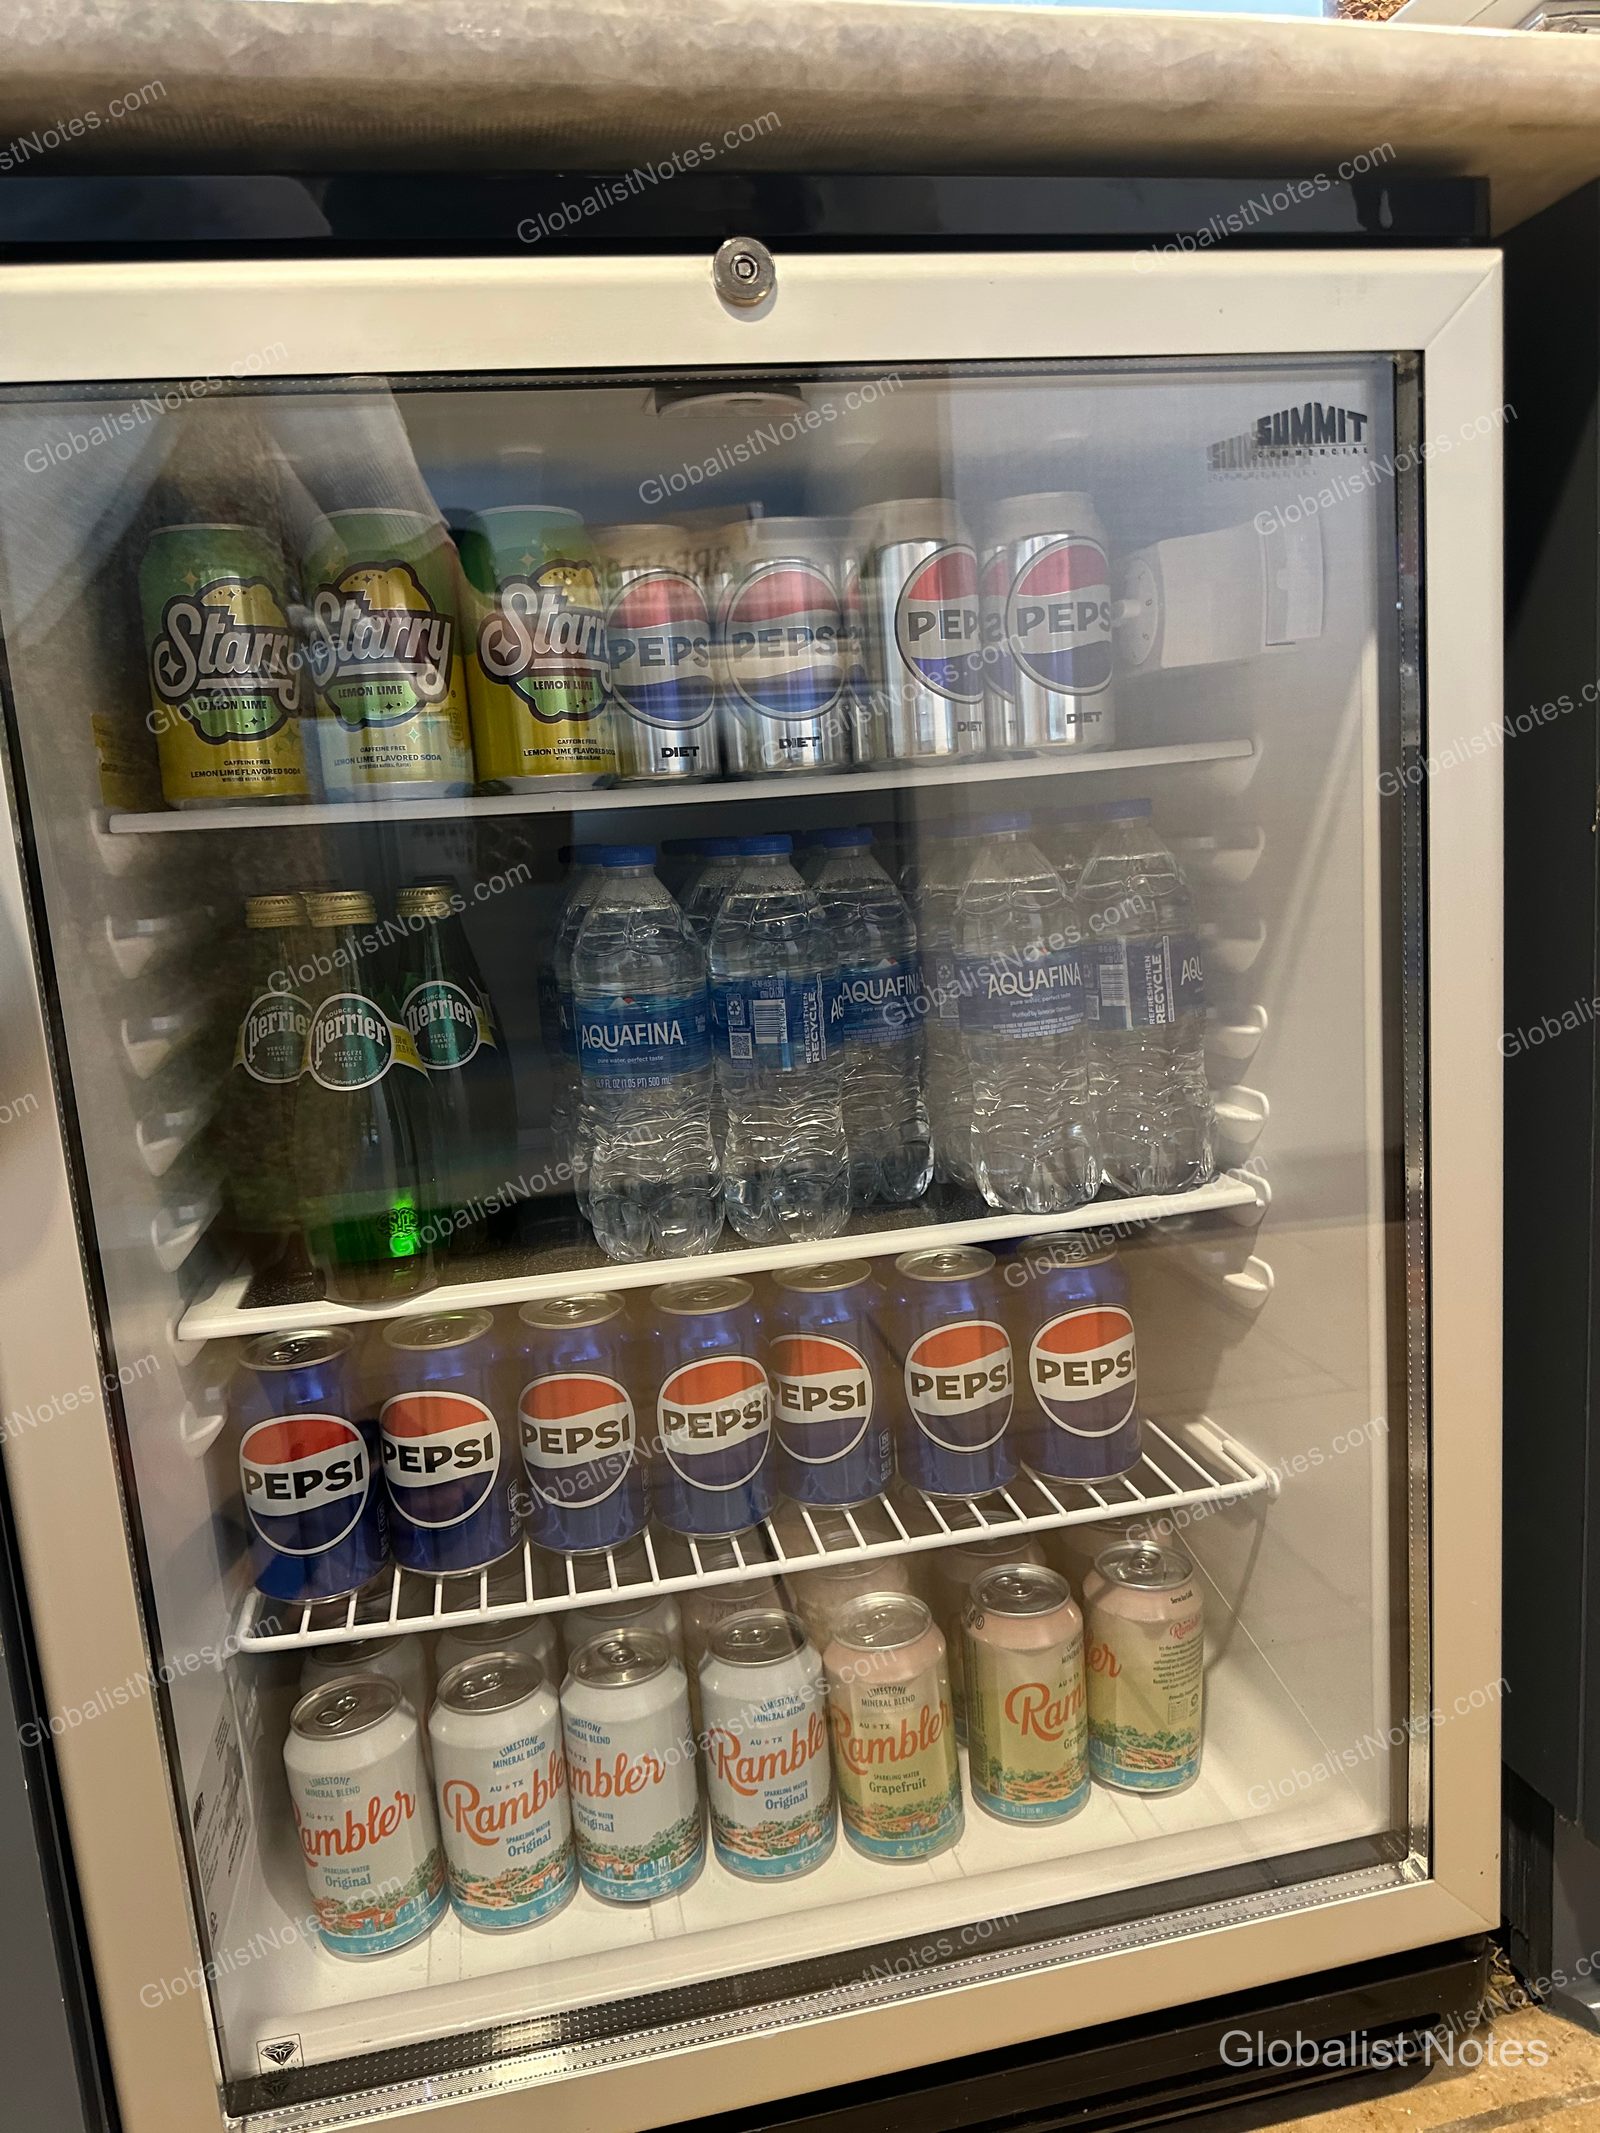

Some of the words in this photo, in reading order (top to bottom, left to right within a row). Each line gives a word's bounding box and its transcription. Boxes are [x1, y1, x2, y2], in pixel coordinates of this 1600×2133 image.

[1257, 402, 1368, 445] SUMMIT
[1258, 447, 1368, 458] COMMERCIAL
[312, 591, 451, 696] Starry
[338, 686, 373, 698] LEMON
[377, 685, 403, 695] LIME
[533, 680, 570, 691] LEMON
[242, 700, 267, 710] LIME
[957, 720, 983, 733] DIET
[1066, 711, 1102, 724] DIET
[523, 749, 552, 757] LEMON
[553, 747, 571, 755] LIME
[778, 736, 820, 749] DIET
[356, 756, 375, 764] LIME
[376, 754, 419, 762] FLAVORED
[420, 753, 442, 761] SODA
[661, 746, 700, 759] DIET
[191, 770, 218, 778] LEMON
[219, 768, 240, 776] LIME
[241, 768, 283, 776] FLAVORED
[1144, 955, 1153, 981] THEN
[988, 962, 1083, 1000] AQUAFINA
[1152, 954, 1166, 1024] RECYCLE
[1146, 984, 1156, 1025] REFRESH
[808, 991, 821, 1062] RECYCLE
[581, 1020, 684, 1053] AQUAFINA
[804, 1023, 812, 1064] REFRESH
[648, 1076, 660, 1086] 500
[911, 1362, 1013, 1401] PEPSI
[663, 1398, 769, 1439] PEPSI
[521, 1414, 631, 1454] PEPSI
[382, 1432, 493, 1474] PEPSI
[243, 1456, 362, 1501] PEPSI
[861, 1698, 892, 1708] MINERAL
[894, 1694, 916, 1706] BLEND
[867, 1686, 907, 1698] LIMESTONE
[753, 1712, 785, 1723] MINERAL
[787, 1702, 806, 1718] BLEND
[499, 1736, 539, 1757] LIMESTONE
[589, 1735, 611, 1745] BLEND
[772, 1736, 783, 1744] TX
[831, 1699, 950, 1776] Rambler
[492, 1753, 525, 1769] MINERAL
[527, 1741, 546, 1759] BLEND
[309, 1776, 350, 1788] LIMESTONE
[512, 1779, 524, 1788] TX
[903, 1770, 920, 1779] WATER
[336, 1786, 360, 1798] BLEND
[869, 1777, 927, 1796] Grapefruit
[765, 1788, 809, 1810] Original
[578, 1810, 615, 1832] Original
[507, 1828, 552, 1857] Original
[325, 1873, 371, 1890] Original
